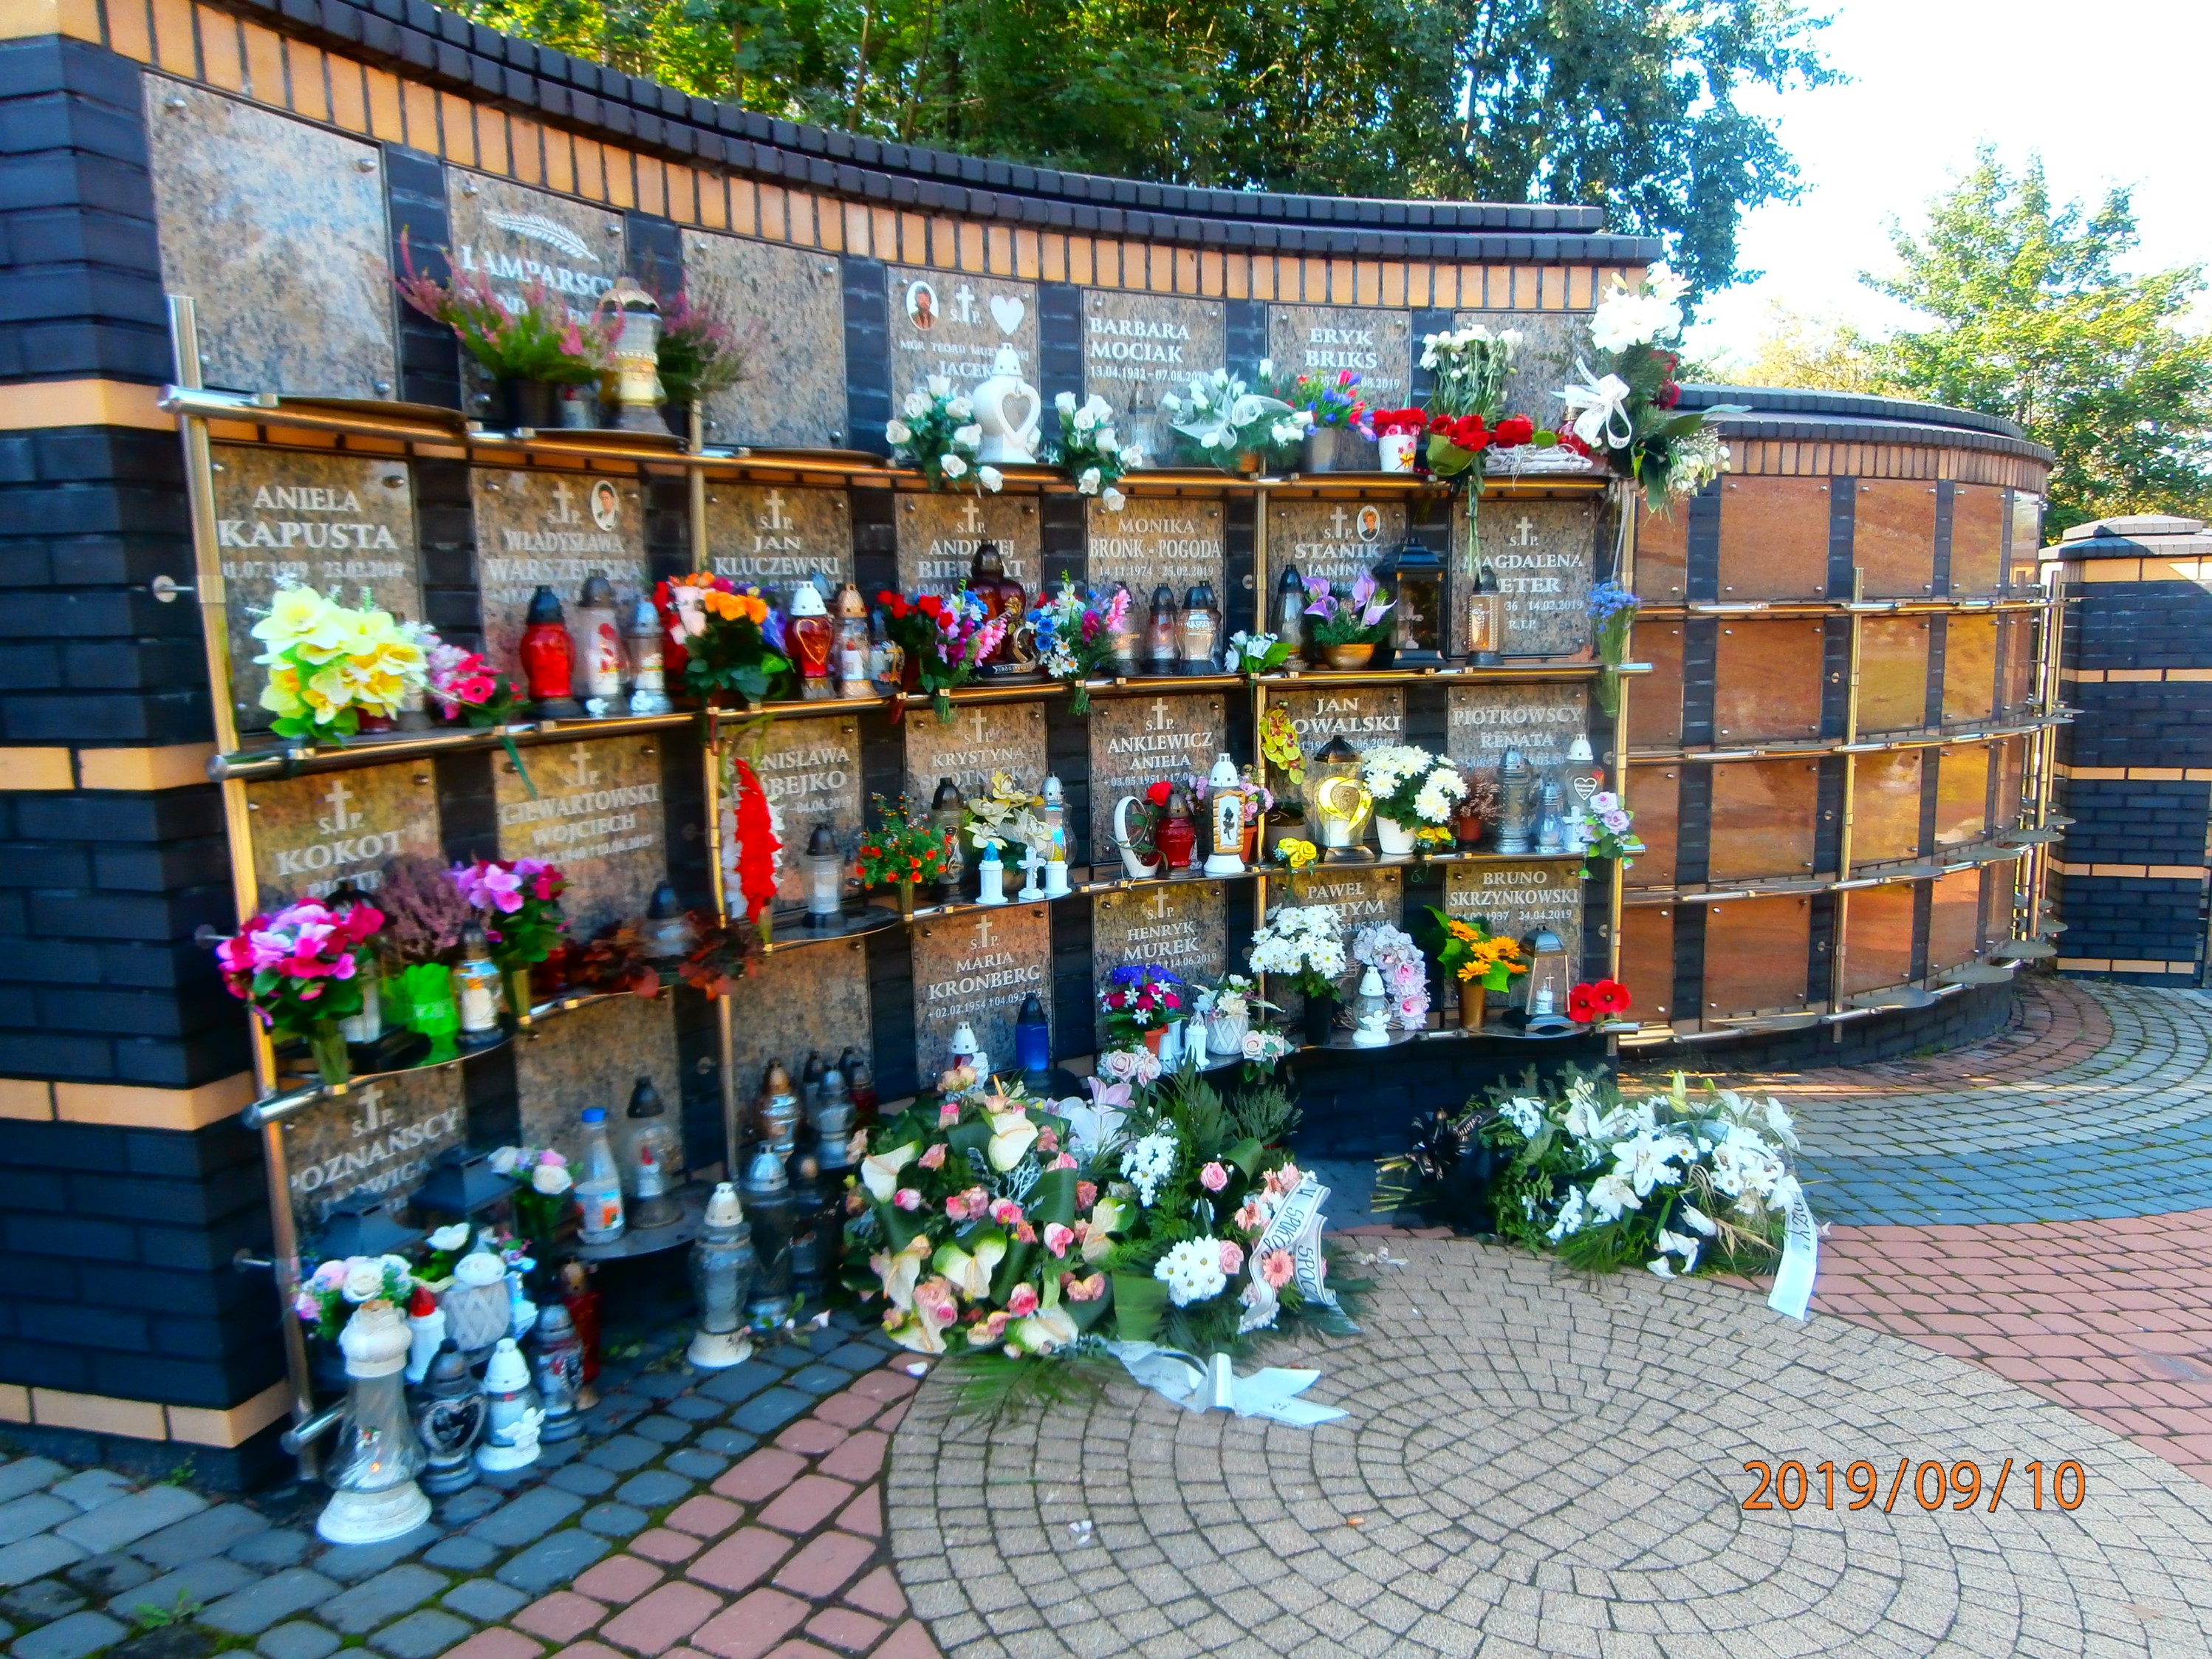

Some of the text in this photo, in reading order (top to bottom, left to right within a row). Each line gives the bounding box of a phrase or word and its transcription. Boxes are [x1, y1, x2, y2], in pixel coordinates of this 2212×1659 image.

[1089, 317, 1191, 341] BARBARA
[1309, 327, 1373, 346] ERYK
[1090, 340, 1183, 363] MOCIAK
[1304, 349, 1378, 369] BRIKS
[253, 485, 362, 513] ANIELA
[218, 519, 400, 550] KAPUSTA
[1117, 518, 1195, 533] MONIKA
[753, 536, 801, 553] JAN
[1089, 538, 1145, 558] BRONK
[1158, 539, 1222, 558] POGODA
[1294, 543, 1381, 559] STANIK
[713, 556, 840, 575] KLUCZEWSKI
[917, 559, 1027, 578] BIERT
[1307, 563, 1366, 578] JANINA
[1497, 578, 1561, 593] ETER
[1528, 600, 1583, 612] 14.02.2019
[1315, 697, 1360, 716] JAN
[1452, 707, 1583, 725] PIOTROWSCY
[1291, 716, 1401, 734] OWALSKI
[1107, 731, 1213, 753] ANKLEWICZ
[1480, 730, 1555, 748] RENATA
[931, 747, 1024, 768] KRYSTYNA
[1129, 753, 1191, 770] ANIELA
[274, 829, 406, 876] KOKOT
[1482, 871, 1548, 886] BRUNO
[1307, 882, 1365, 900] PAWEŁ
[1518, 909, 1572, 920] 24.04.2019
[1126, 920, 1196, 942] HENRYK
[1122, 937, 1200, 962] MUREK
[955, 951, 1015, 974] MARIA
[1170, 952, 1218, 968] 14.06.2019
[928, 963, 1041, 1001] KRONBERG
[934, 1001, 987, 1019] 02.02.1954
